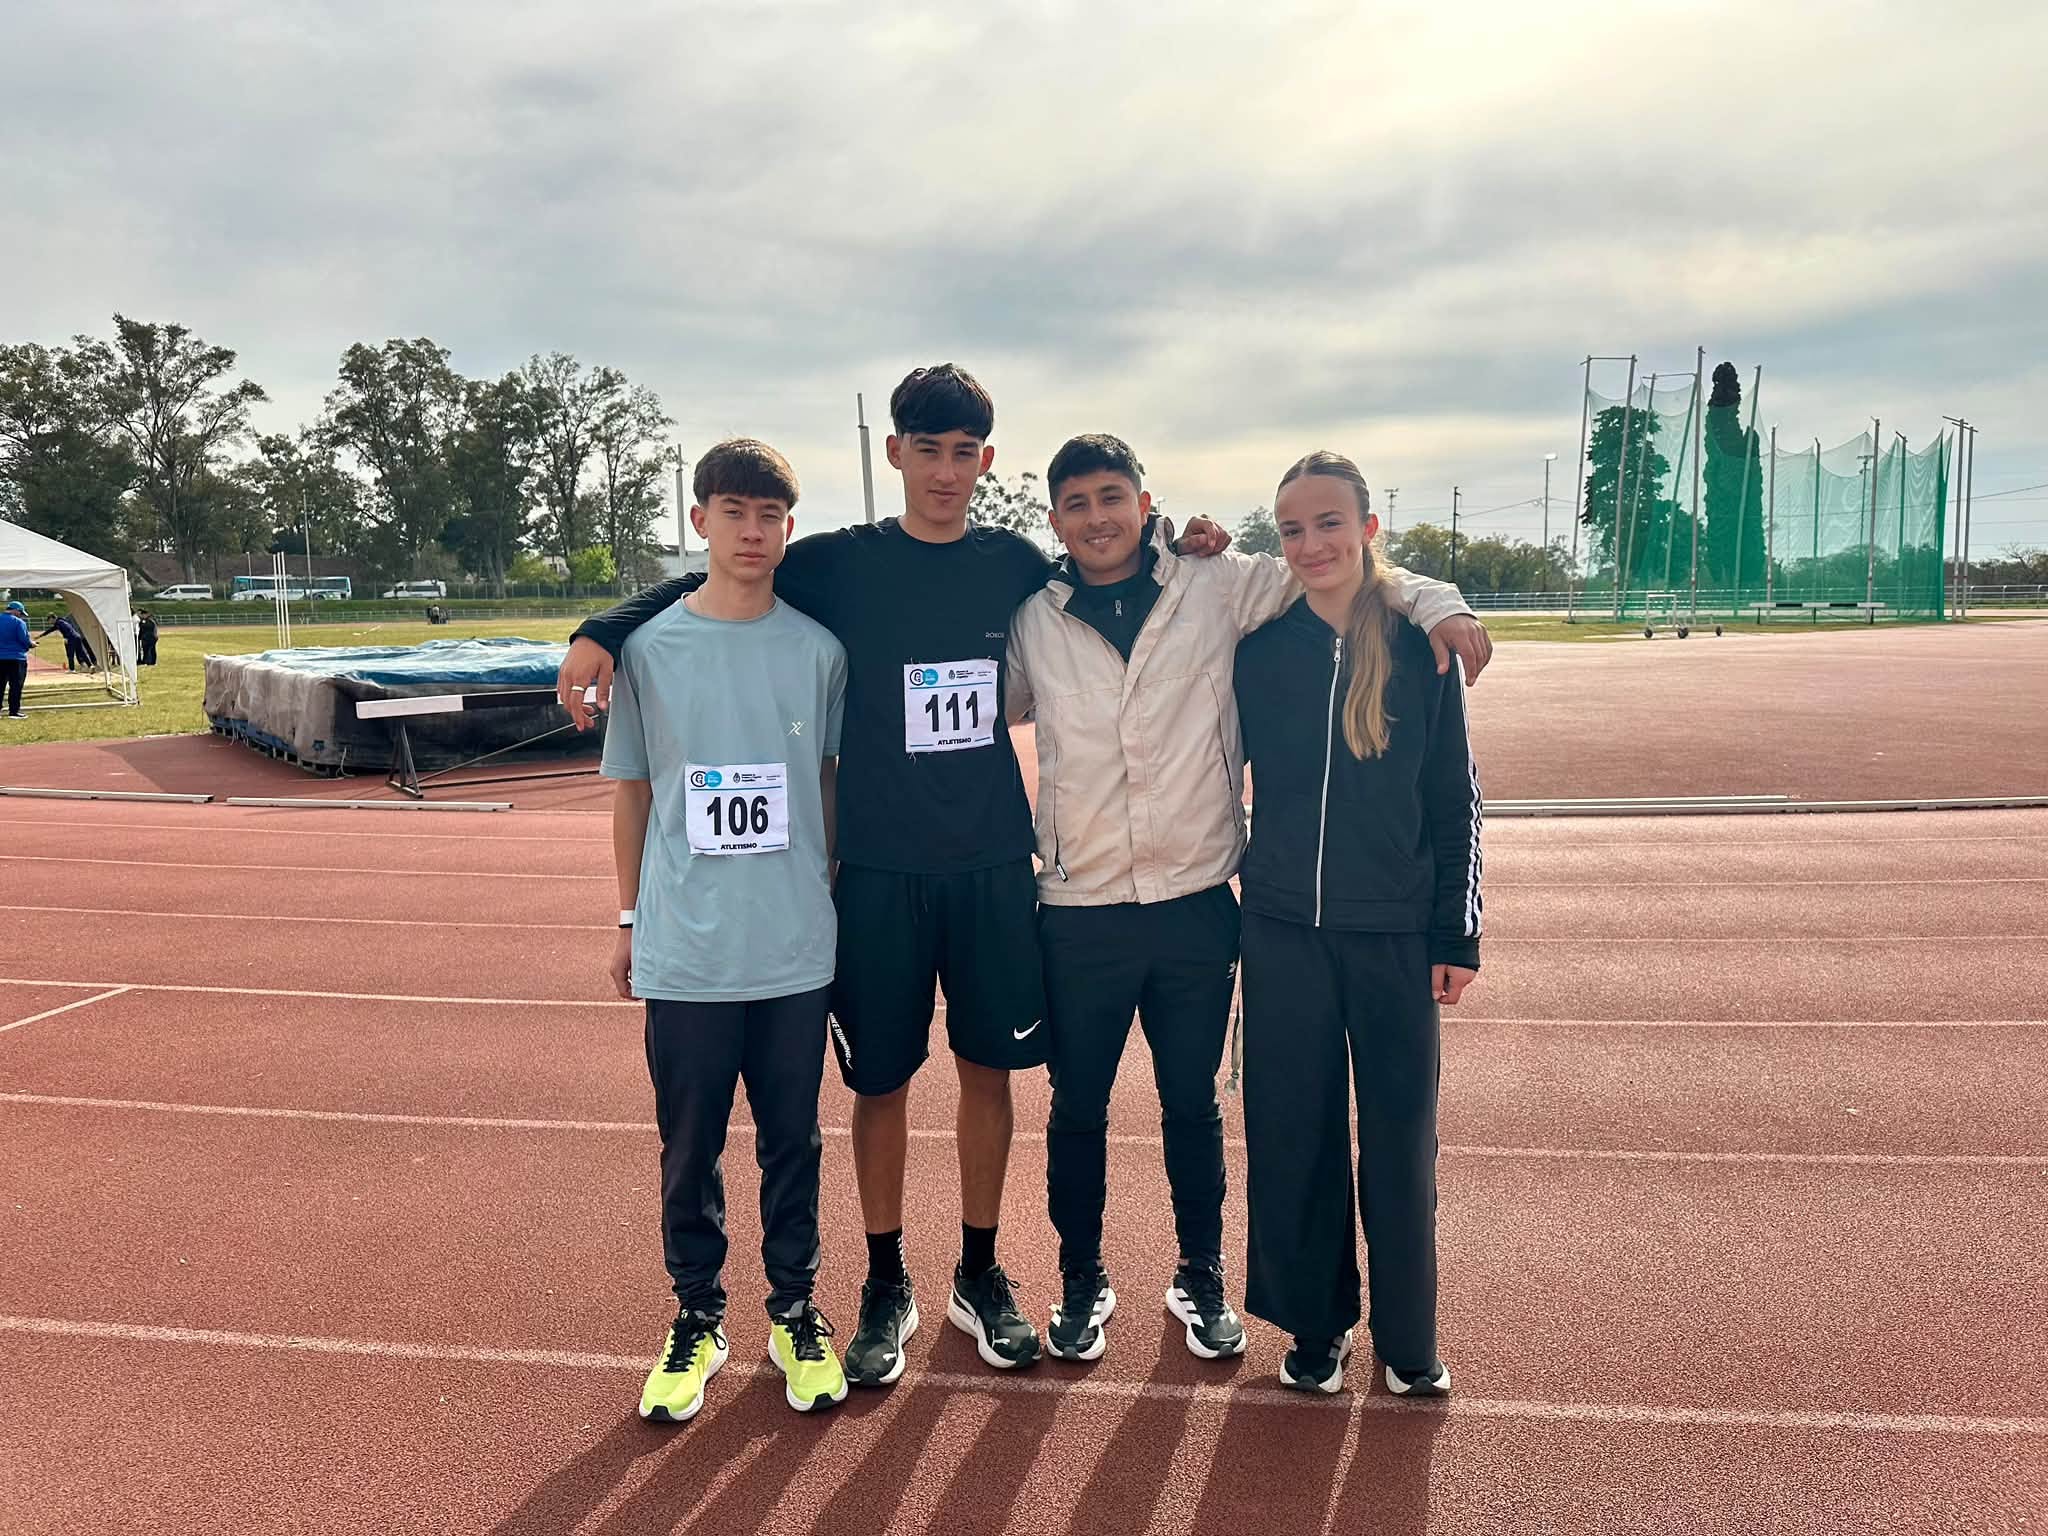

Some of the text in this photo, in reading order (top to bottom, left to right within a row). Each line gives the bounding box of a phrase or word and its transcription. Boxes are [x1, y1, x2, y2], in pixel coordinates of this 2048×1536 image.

[925, 691, 979, 732] 111
[938, 737, 972, 745] ATLETISMO
[707, 795, 768, 836] 106
[720, 842, 758, 850] ATLETISMO
[834, 1028, 852, 1058] RUNNING
